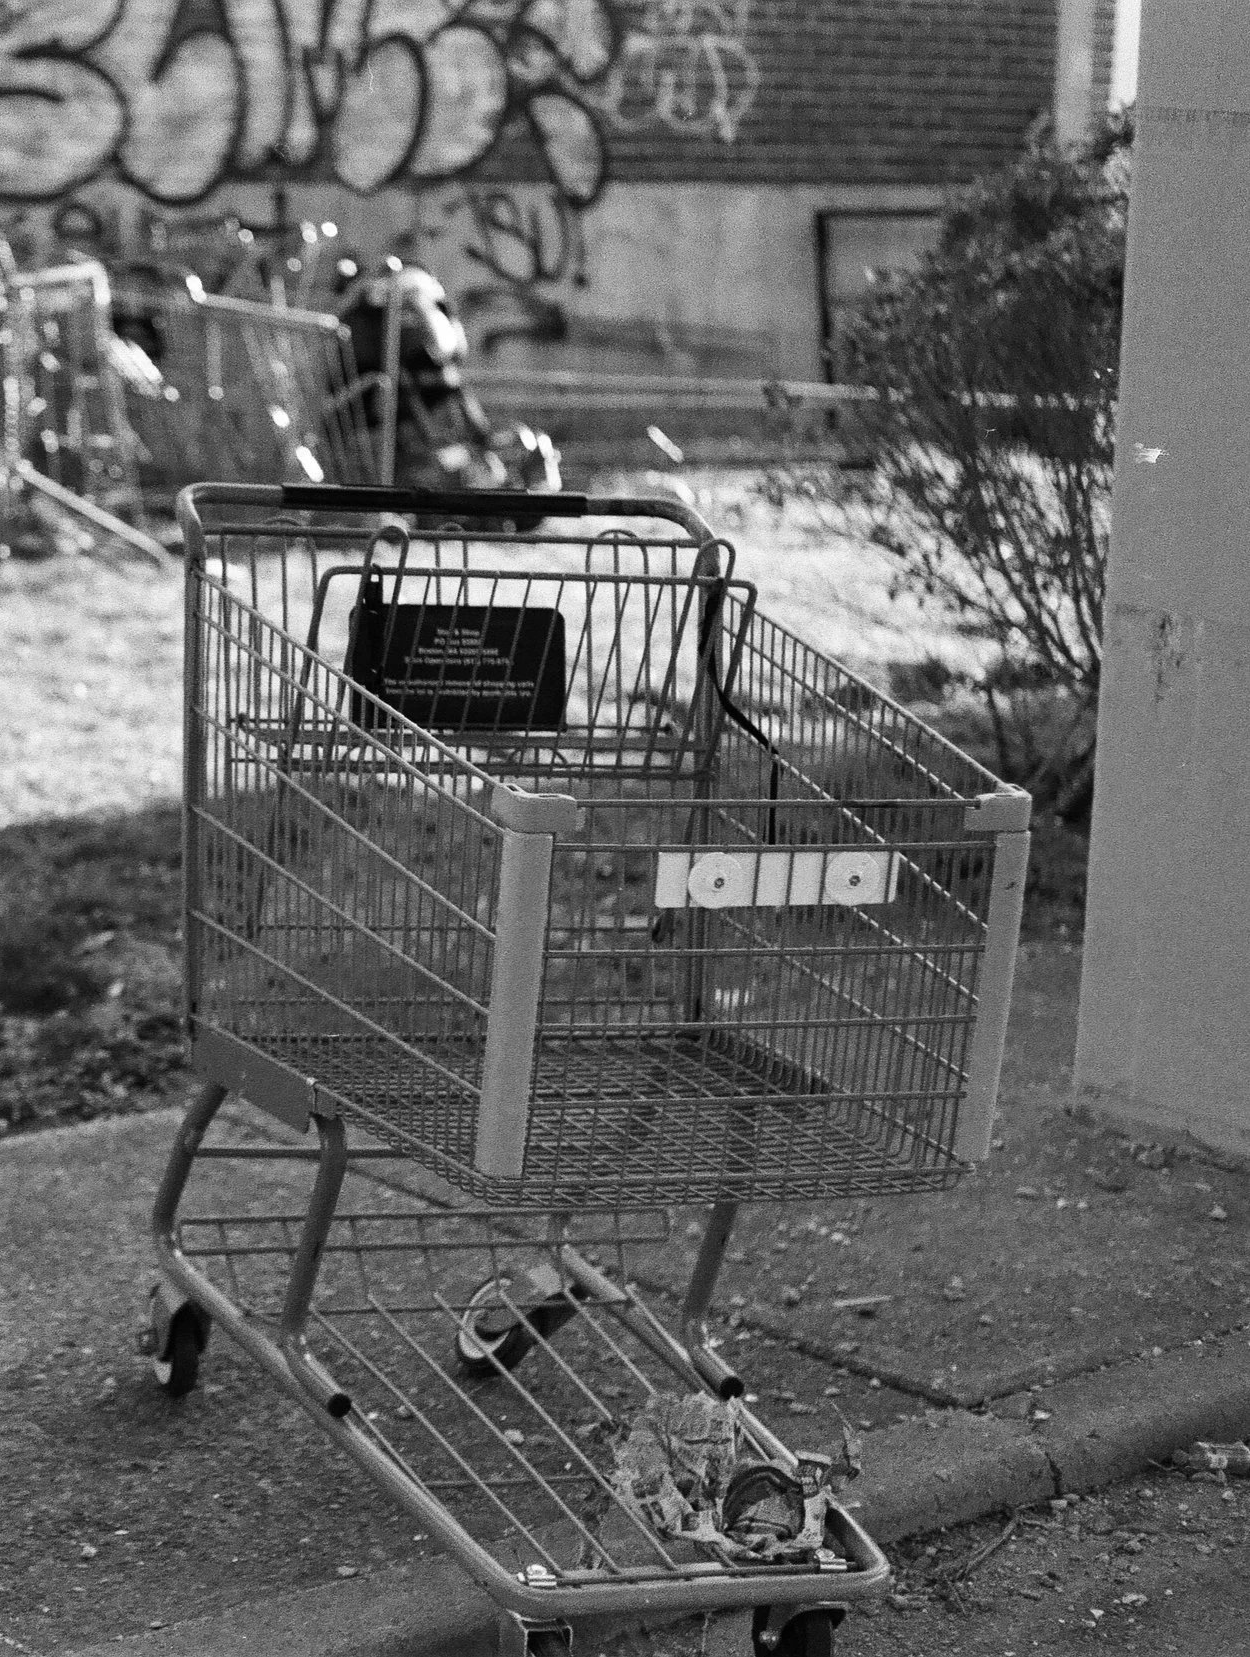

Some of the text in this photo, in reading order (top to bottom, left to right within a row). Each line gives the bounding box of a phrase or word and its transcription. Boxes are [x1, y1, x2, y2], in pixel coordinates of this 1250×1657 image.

[436, 628, 452, 636] Sto
[434, 637, 445, 645] PO
[447, 638, 460, 646] ox
[424, 657, 462, 665] Operaions
[483, 680, 516, 688] shoppng
[435, 689, 470, 697] rohibite
